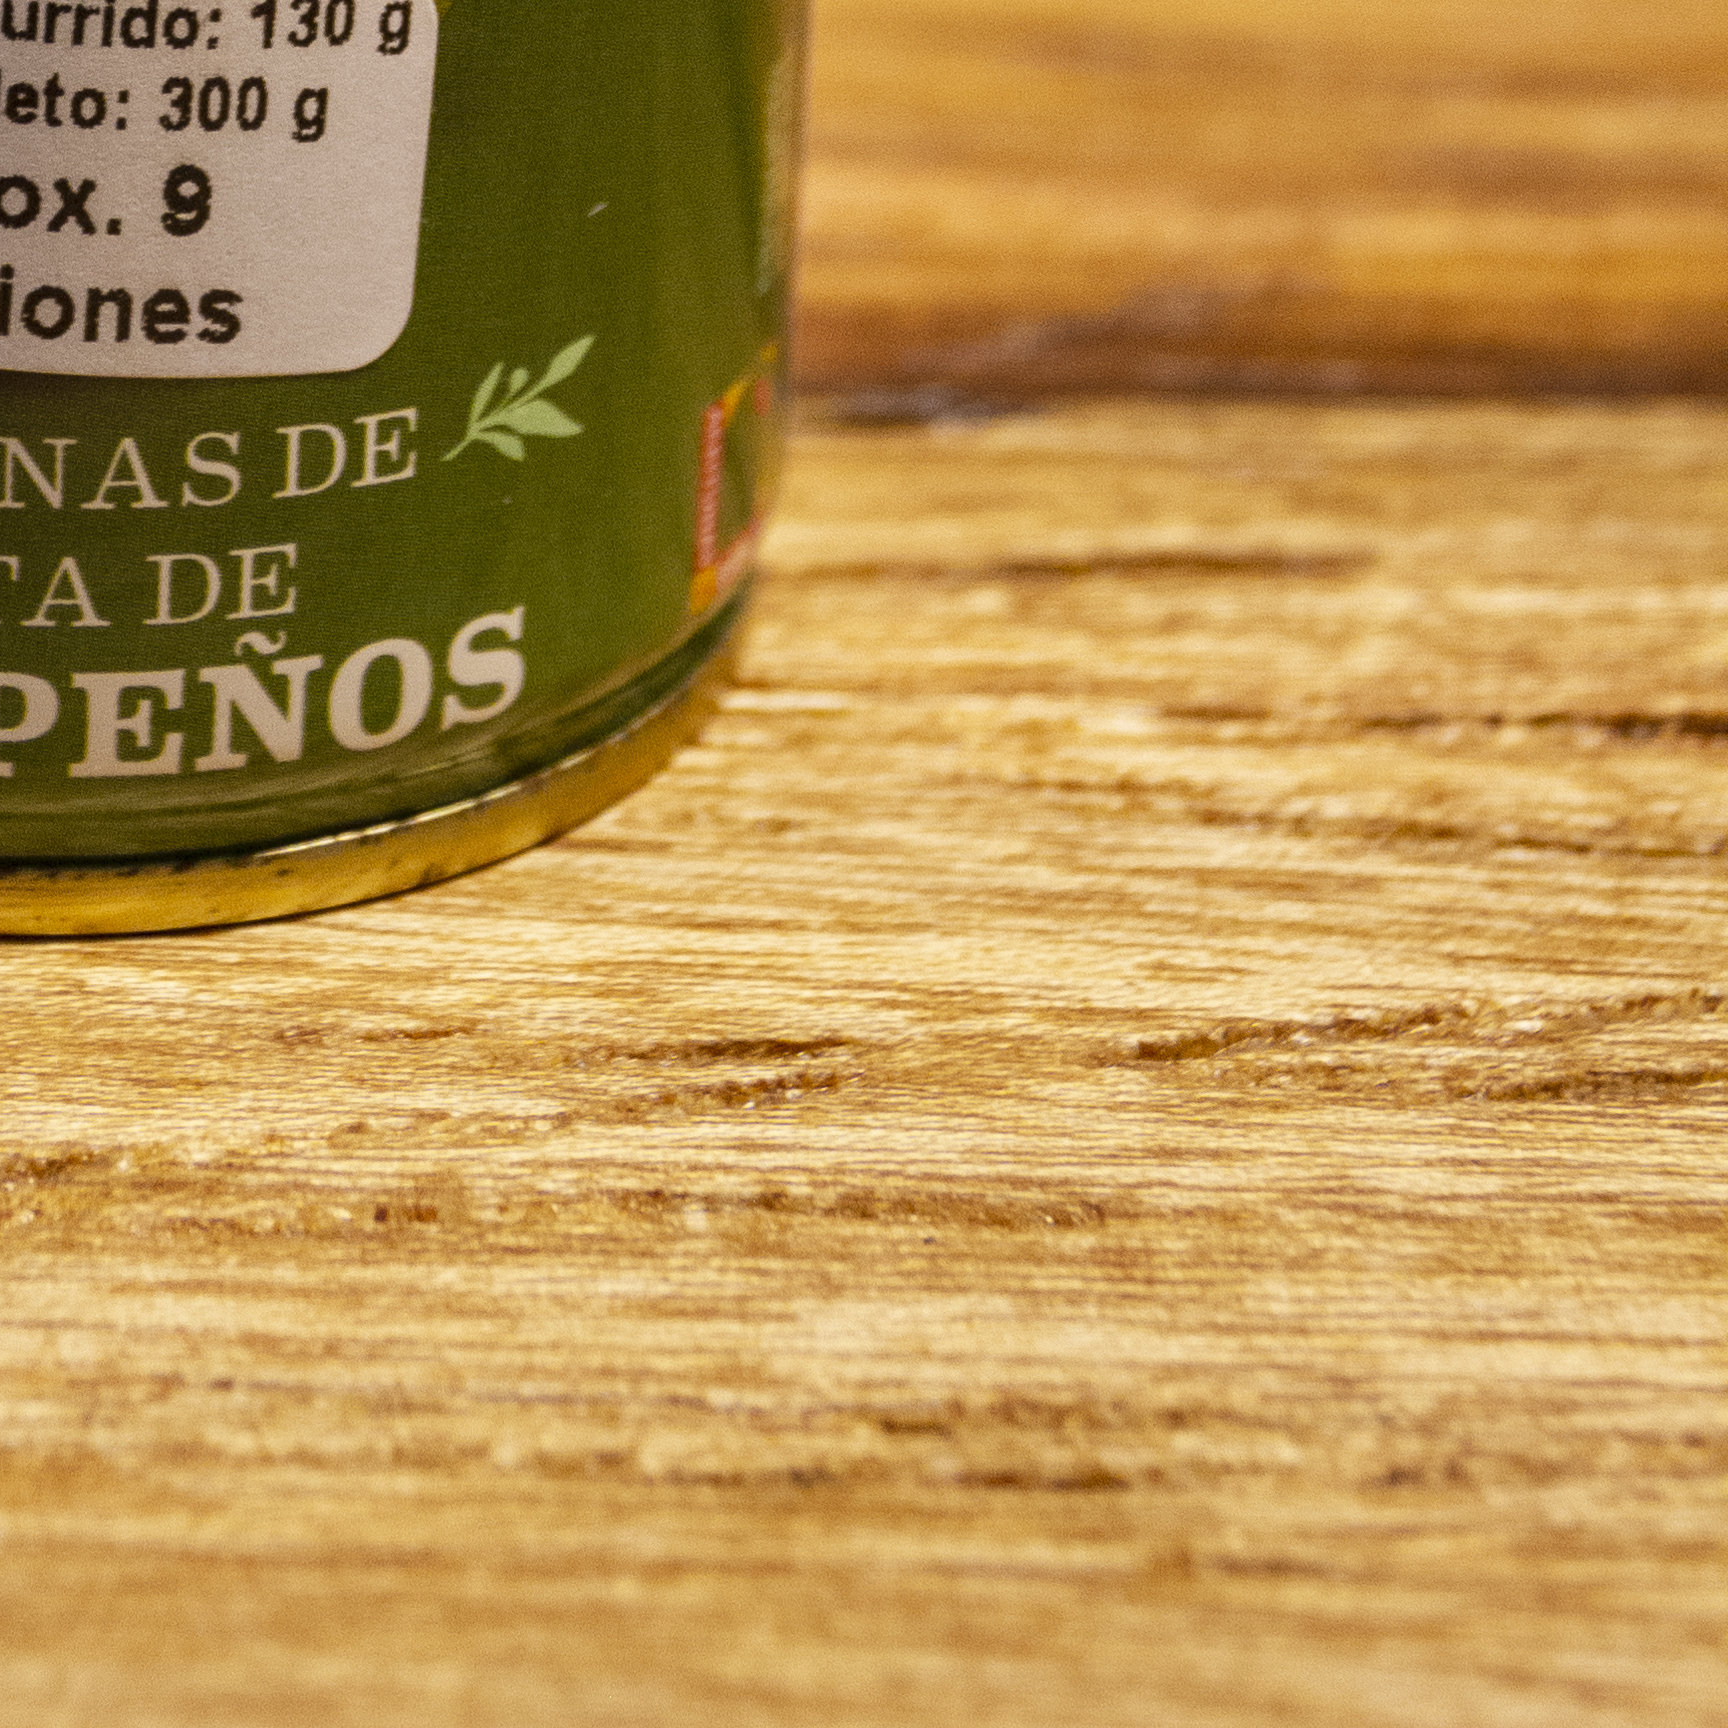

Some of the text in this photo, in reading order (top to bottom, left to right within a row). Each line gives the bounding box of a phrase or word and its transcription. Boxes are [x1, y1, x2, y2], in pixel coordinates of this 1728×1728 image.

[376, 0, 413, 55] g
[158, 75, 268, 132] 300
[292, 86, 329, 143] g
[161, 164, 212, 236] 9
[273, 408, 419, 501] DE
[144, 543, 300, 627] DE
